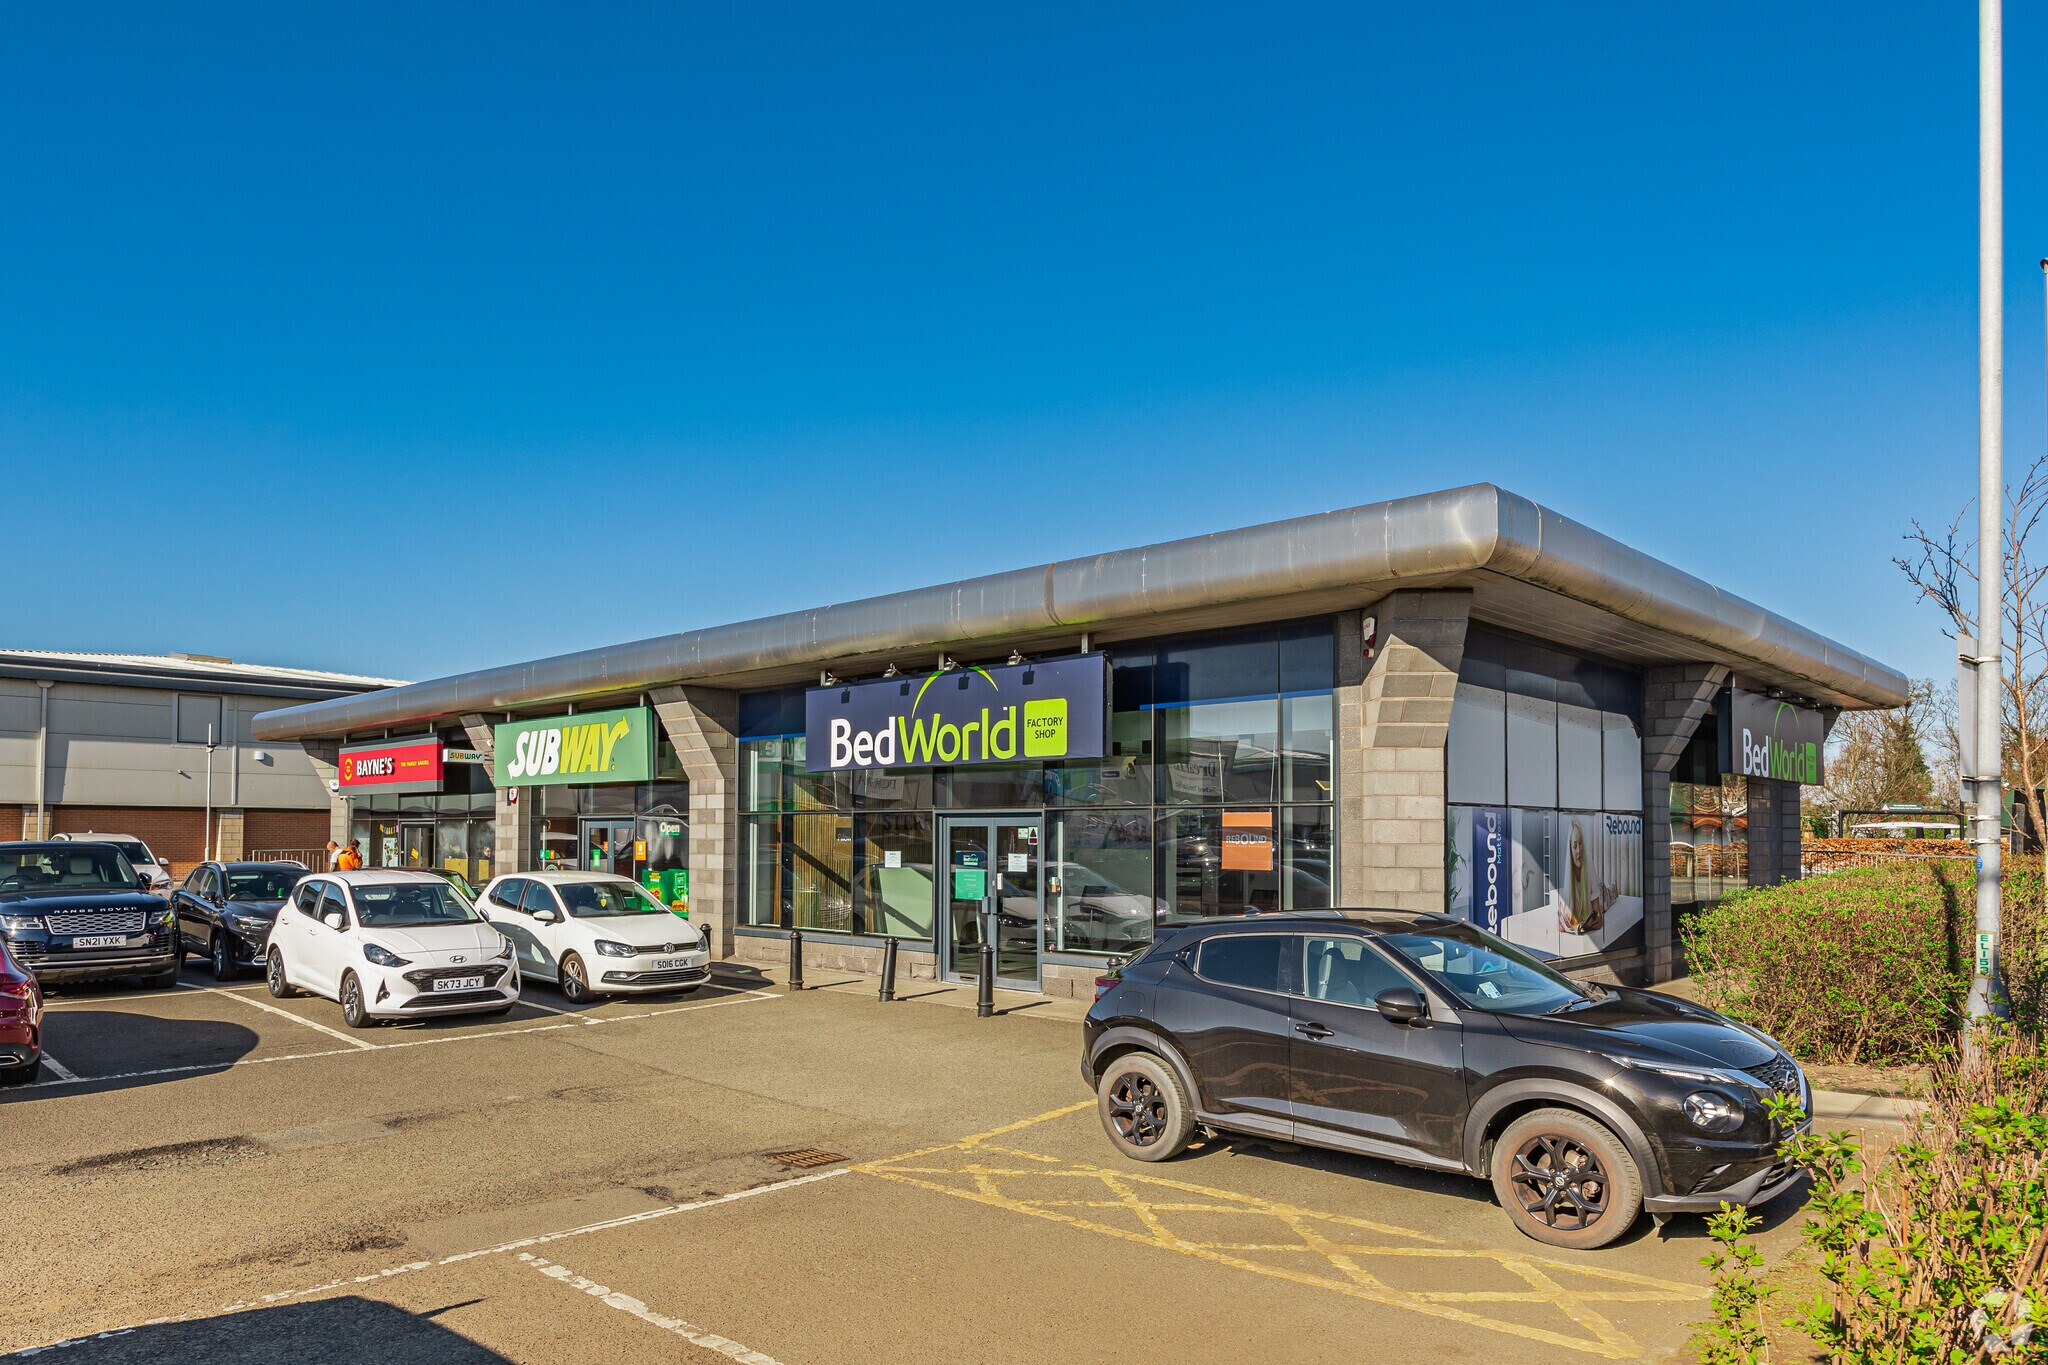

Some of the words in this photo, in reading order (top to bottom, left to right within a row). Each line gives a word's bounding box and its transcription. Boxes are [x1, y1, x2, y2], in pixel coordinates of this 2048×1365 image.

[1027, 717, 1064, 728] FACTORY
[1034, 729, 1056, 739] SHOP
[508, 716, 630, 780] SUBWAY
[449, 752, 482, 761] SUBWAY
[356, 757, 393, 776] BAYNE'S
[659, 821, 680, 838] Open
[1606, 815, 1641, 835] Rebound
[79, 937, 101, 947] SN21
[103, 936, 121, 946] YXK
[657, 960, 673, 969] SO16
[674, 958, 688, 968] CGK
[437, 979, 461, 990] SK73
[463, 978, 480, 988] JCY
